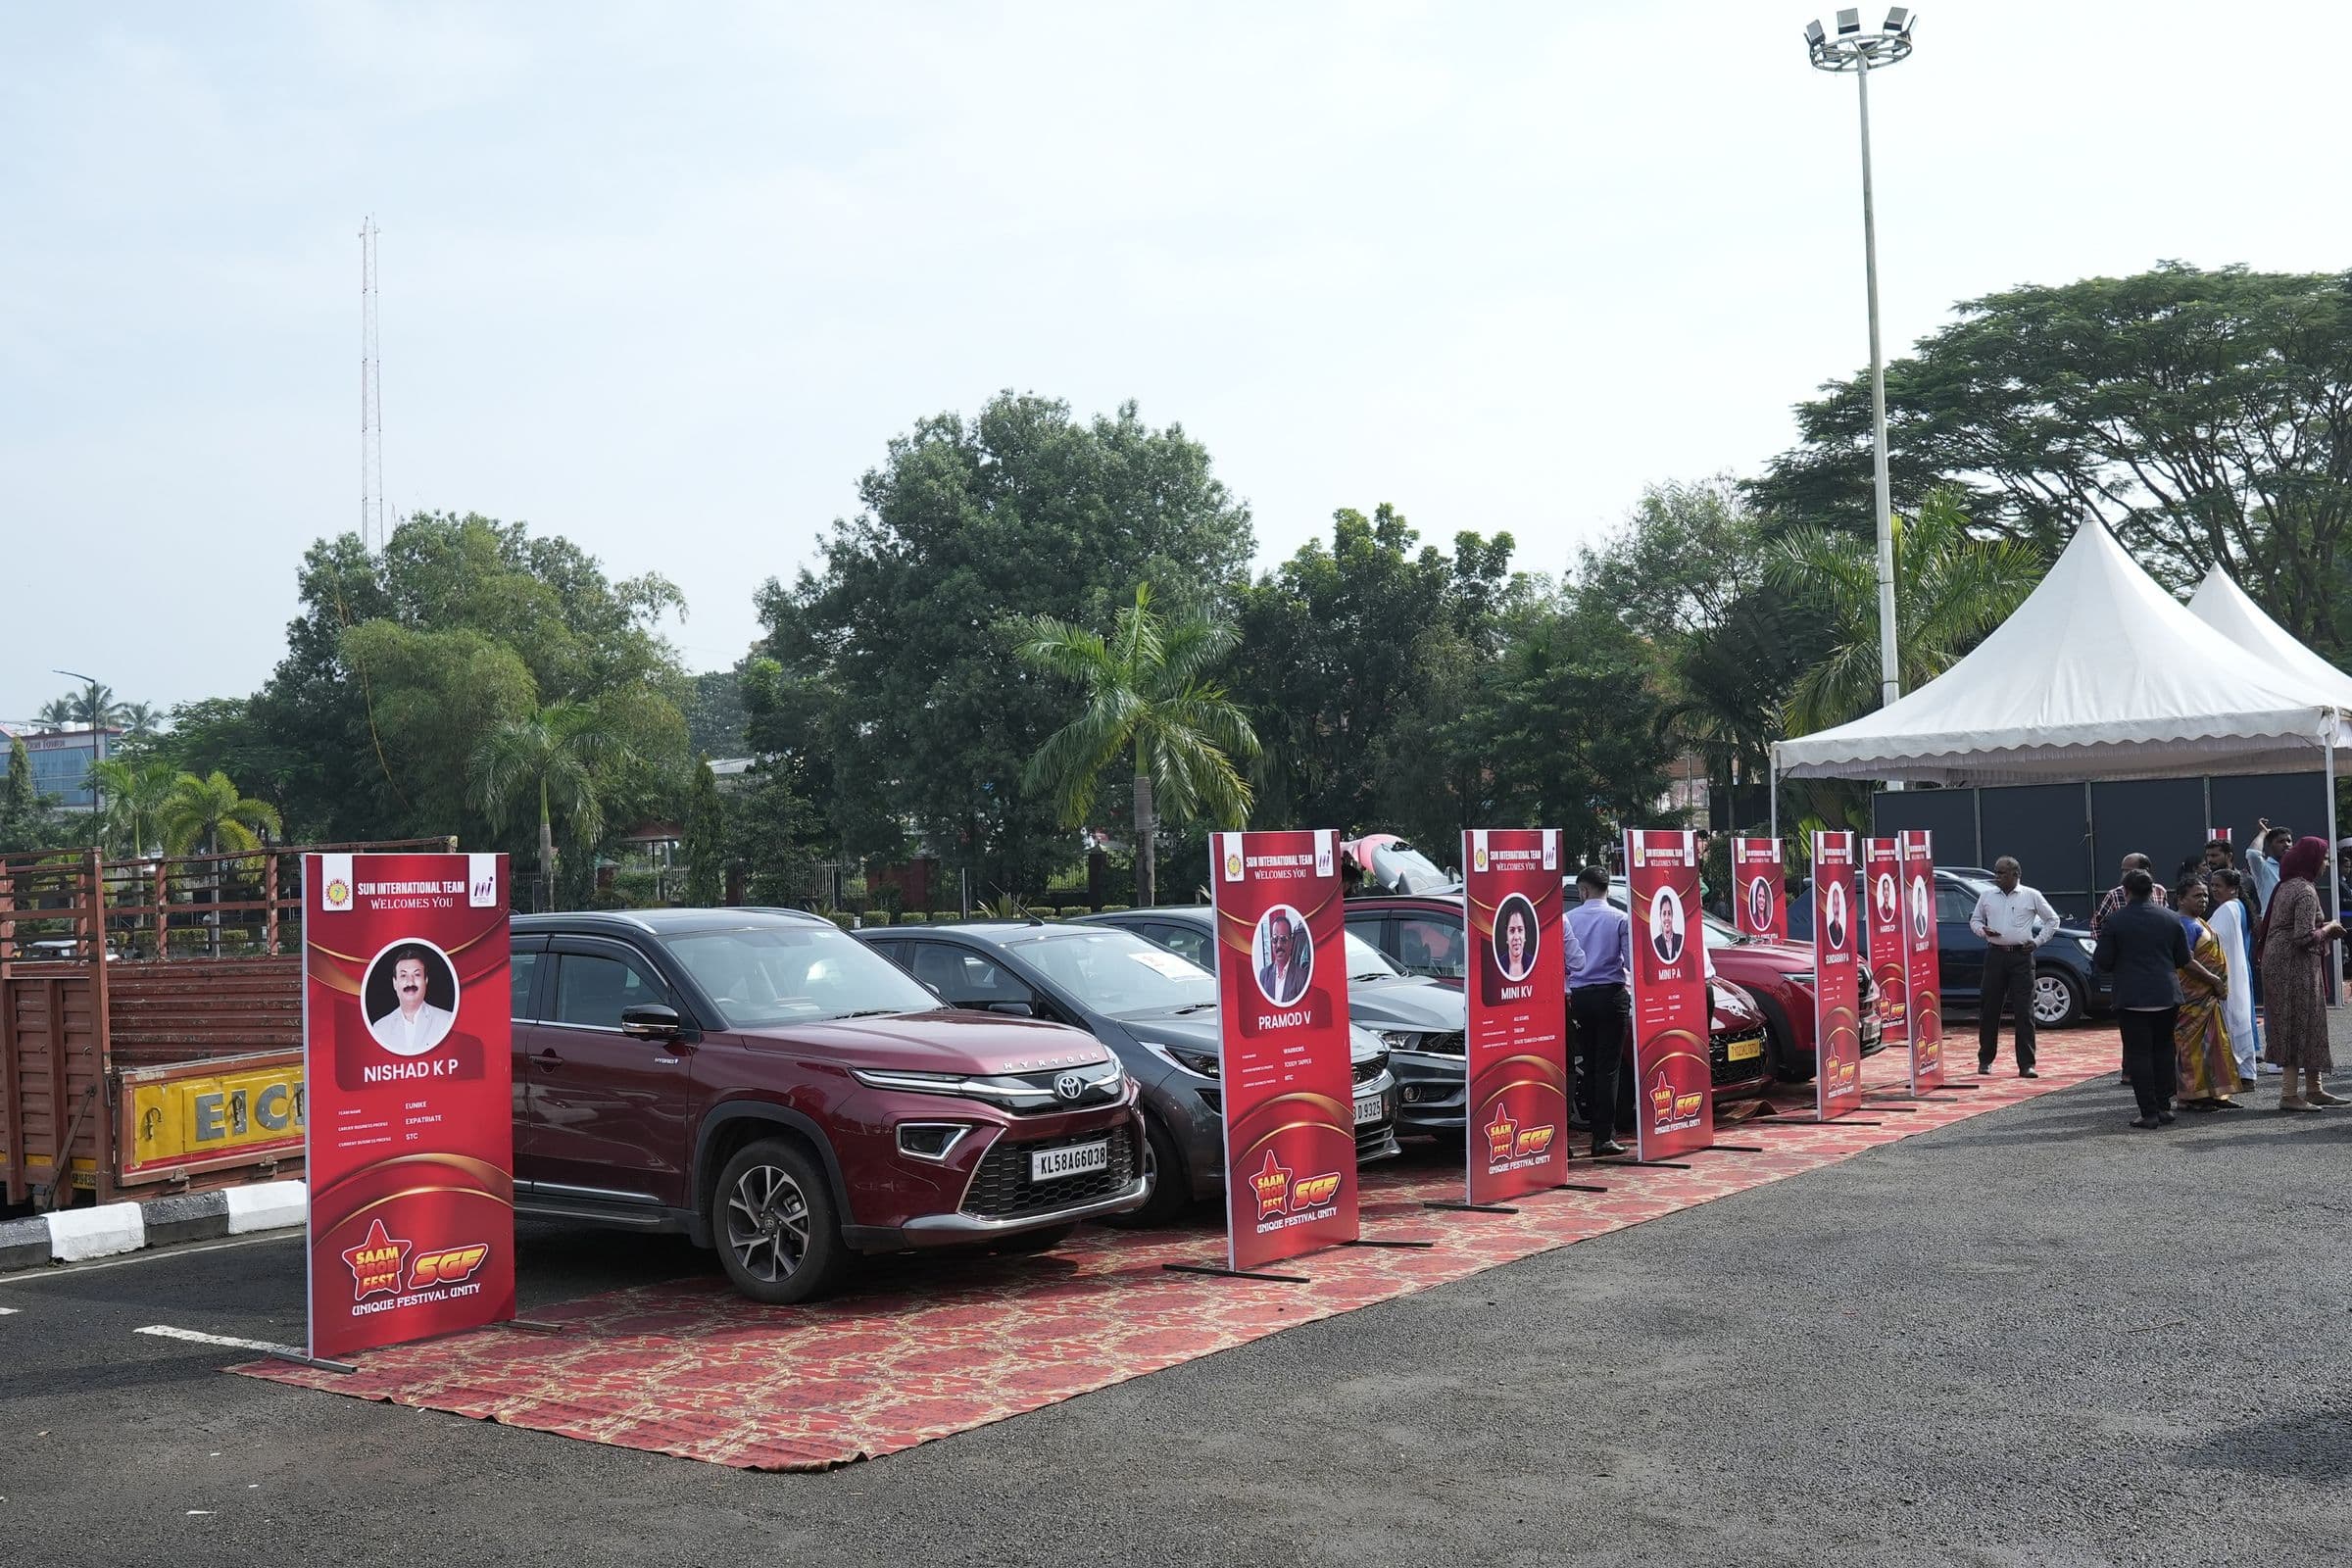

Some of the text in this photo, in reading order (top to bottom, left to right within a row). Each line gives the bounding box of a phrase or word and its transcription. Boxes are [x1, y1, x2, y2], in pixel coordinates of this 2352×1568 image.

[1246, 855, 1313, 867] SUN INTERNATIONAL TEAM
[1495, 862, 1524, 871] WELCOMES
[1254, 868, 1306, 880] WELCOMES YOU
[358, 881, 465, 895] SUN INTERNATIONAL TEAM
[370, 897, 454, 909] WELCOMES YOU
[1658, 967, 1682, 981] MINI P A
[1501, 985, 1533, 1001] MINI KV
[1258, 1010, 1311, 1031] PRAMOD V
[1004, 1052, 1099, 1070] HYRYDER
[364, 1058, 459, 1083] NISHAD K P
[405, 1101, 427, 1109] EUNIKE
[406, 1114, 442, 1125] EXPATRIATE
[406, 1132, 418, 1141] STC
[1490, 1123, 1511, 1137] SAAM
[1519, 1128, 1552, 1152] SGF
[1041, 1147, 1105, 1175] KL58AG6038
[1509, 1157, 1535, 1169] FESTIVAL
[1257, 1173, 1285, 1189] SAAM
[1294, 1175, 1339, 1208] SGF
[1262, 1197, 1284, 1211] FEST
[1256, 1206, 1338, 1234] UNIQUE FESTIVAL UNITY
[356, 1246, 399, 1265] SAAM
[413, 1248, 485, 1285] SGF
[363, 1272, 395, 1291] FEST
[352, 1283, 481, 1316] UNIQUE FESTIVAL UNITY
